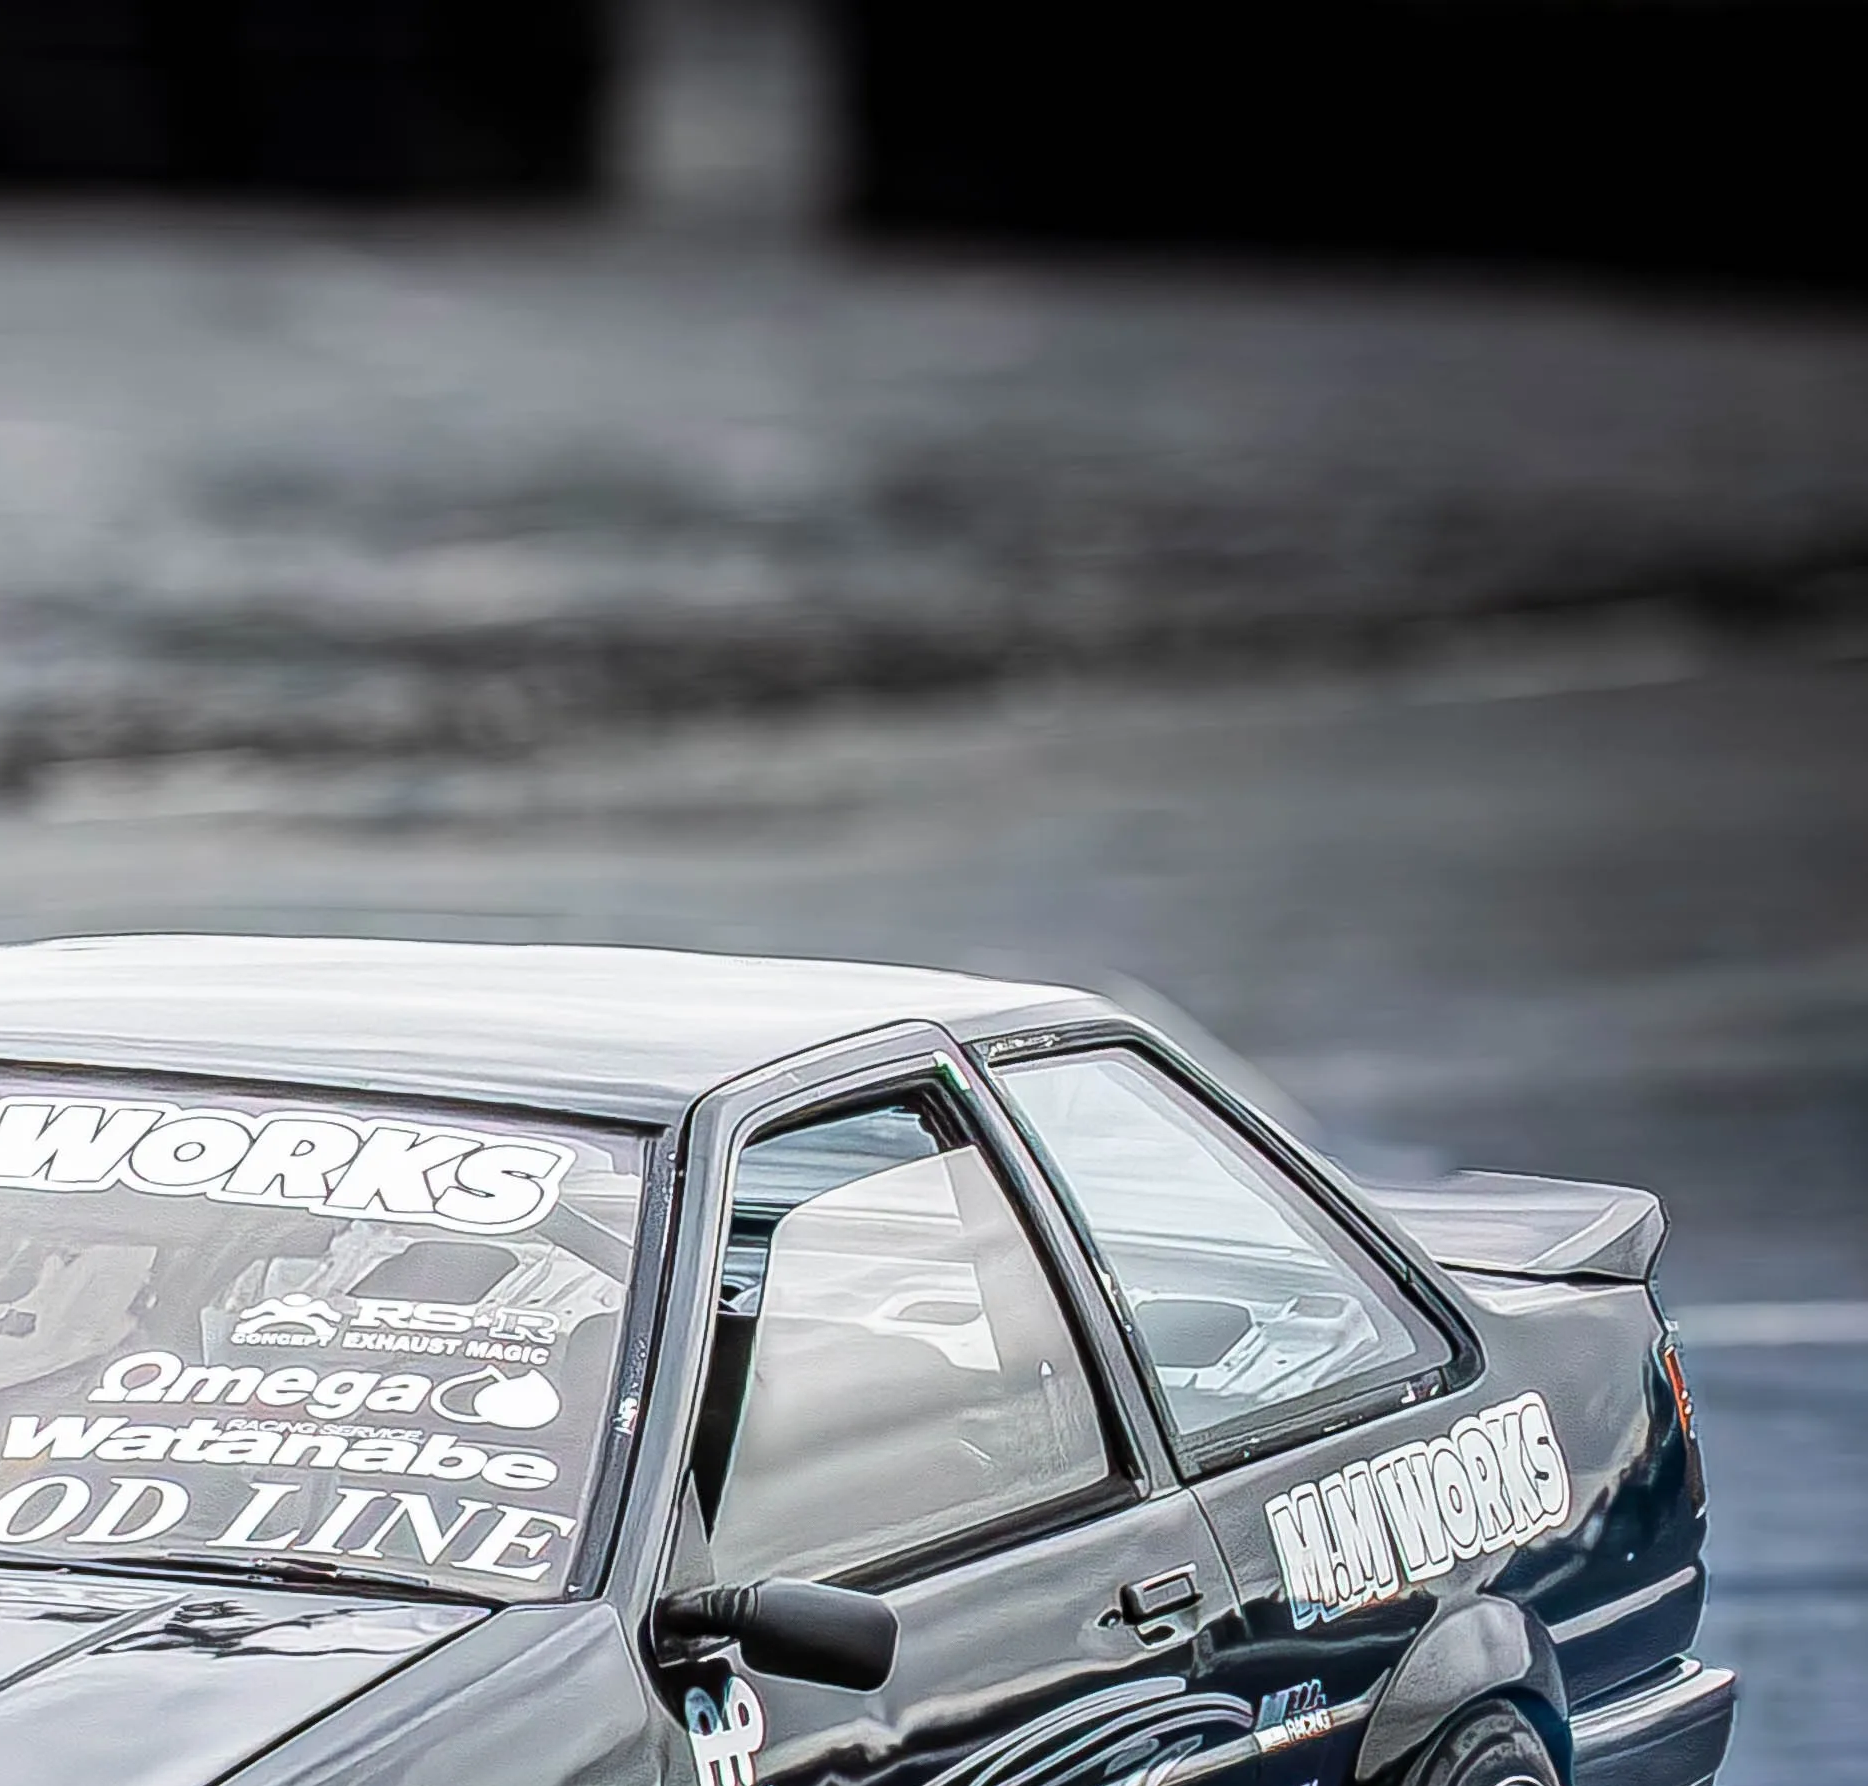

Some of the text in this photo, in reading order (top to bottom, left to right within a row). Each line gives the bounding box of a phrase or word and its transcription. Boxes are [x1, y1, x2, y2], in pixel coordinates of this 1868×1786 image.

[230, 1332, 331, 1347] CONCEPT
[342, 1332, 550, 1365] EXHAUST MAGIC
[1, 1415, 559, 1490] Watanabe
[225, 1419, 425, 1443] RACING SERVICE
[1370, 1391, 1569, 1581] WORKS
[205, 1480, 574, 1582] LINE
